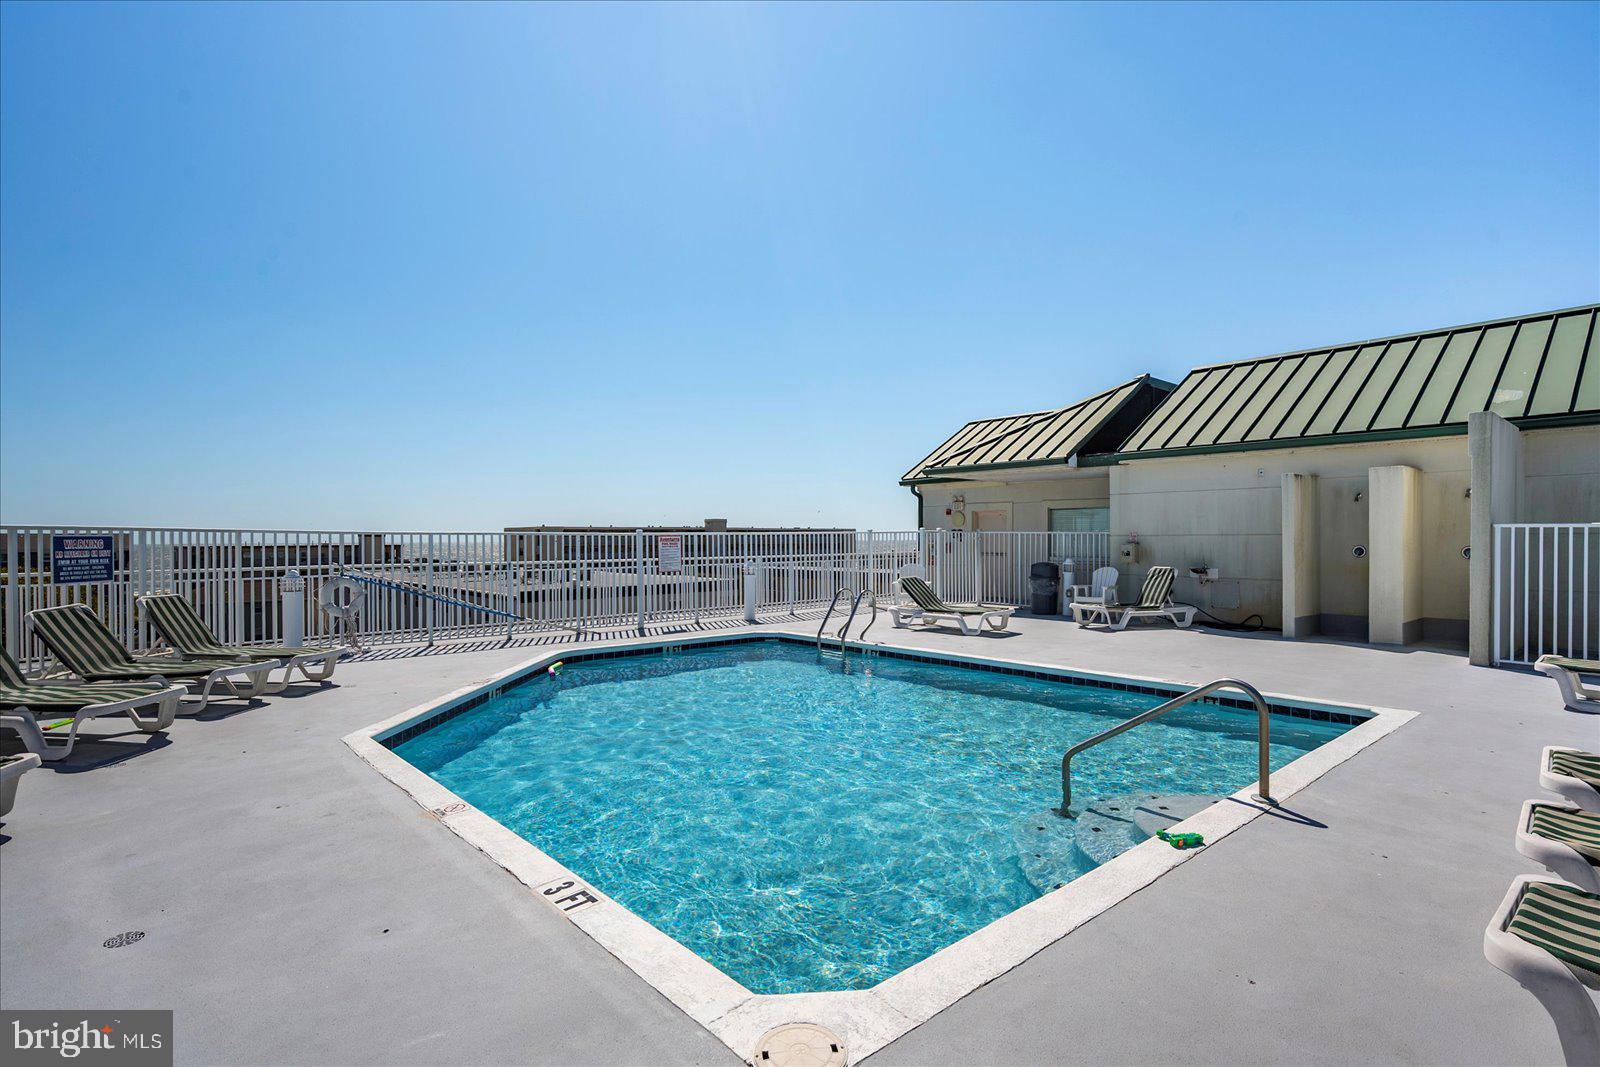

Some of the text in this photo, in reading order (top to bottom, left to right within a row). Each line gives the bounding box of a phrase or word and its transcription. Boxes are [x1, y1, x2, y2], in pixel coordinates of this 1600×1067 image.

[64, 539, 104, 549] WARNING
[544, 881, 599, 911] 3 FT
